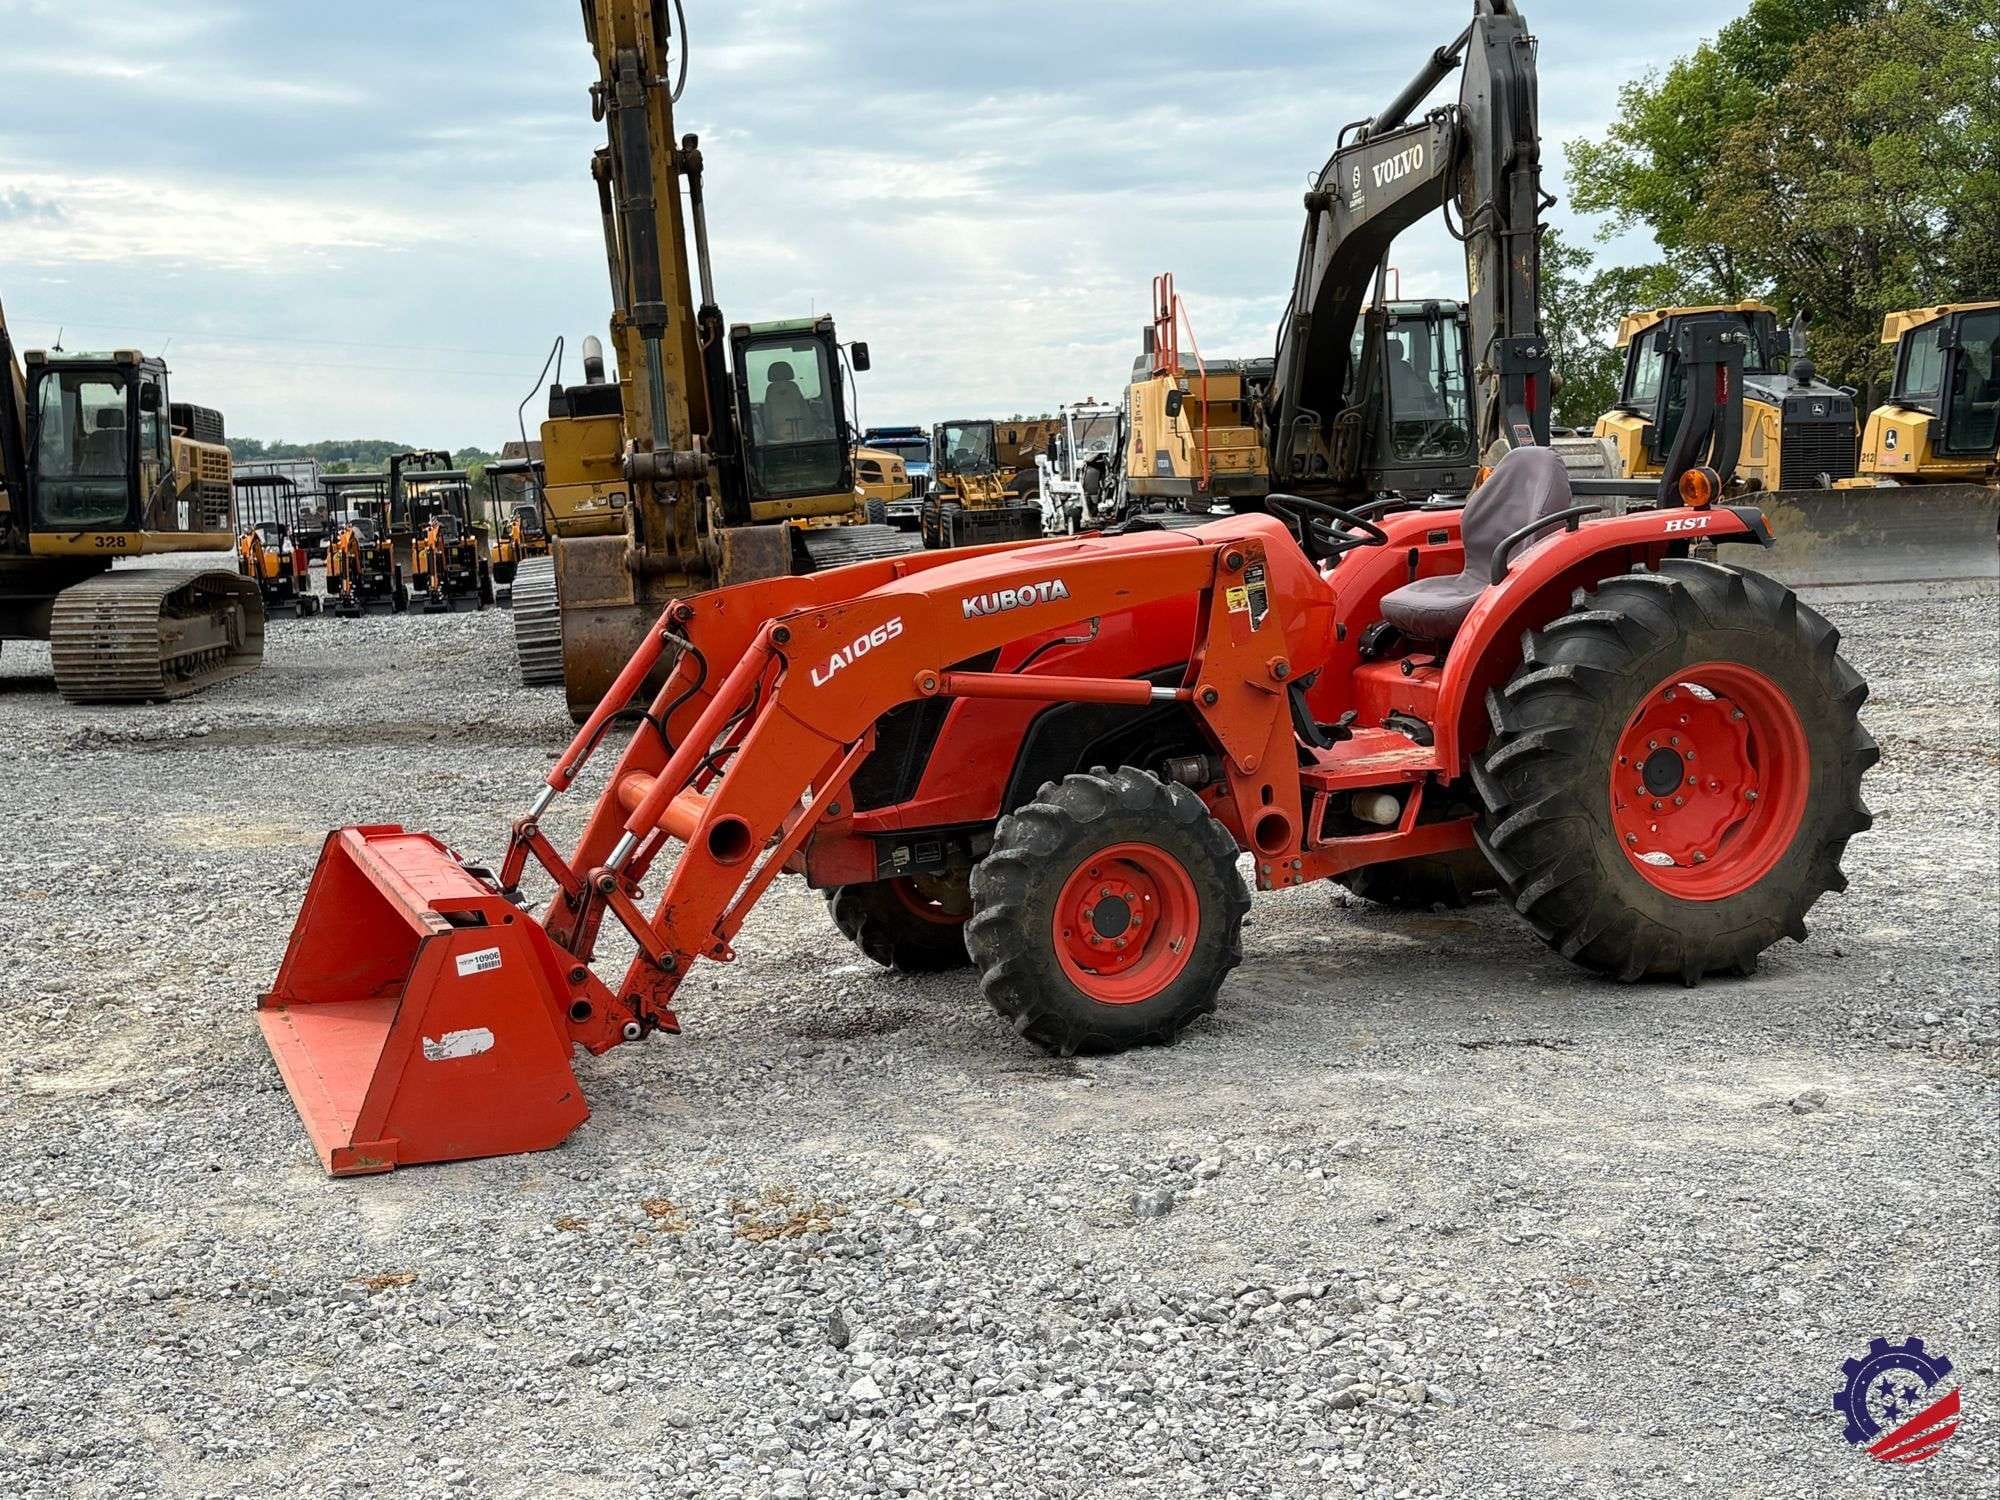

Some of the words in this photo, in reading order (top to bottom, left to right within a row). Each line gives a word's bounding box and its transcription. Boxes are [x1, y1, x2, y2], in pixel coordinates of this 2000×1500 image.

[1372, 144, 1423, 187] VOLVO
[1861, 453, 1875, 463] 212
[1664, 516, 1711, 532] HST
[95, 536, 127, 548] 328
[962, 579, 1069, 618] KUBOTA
[811, 617, 903, 687] LA1065
[474, 952, 499, 963] 10906
